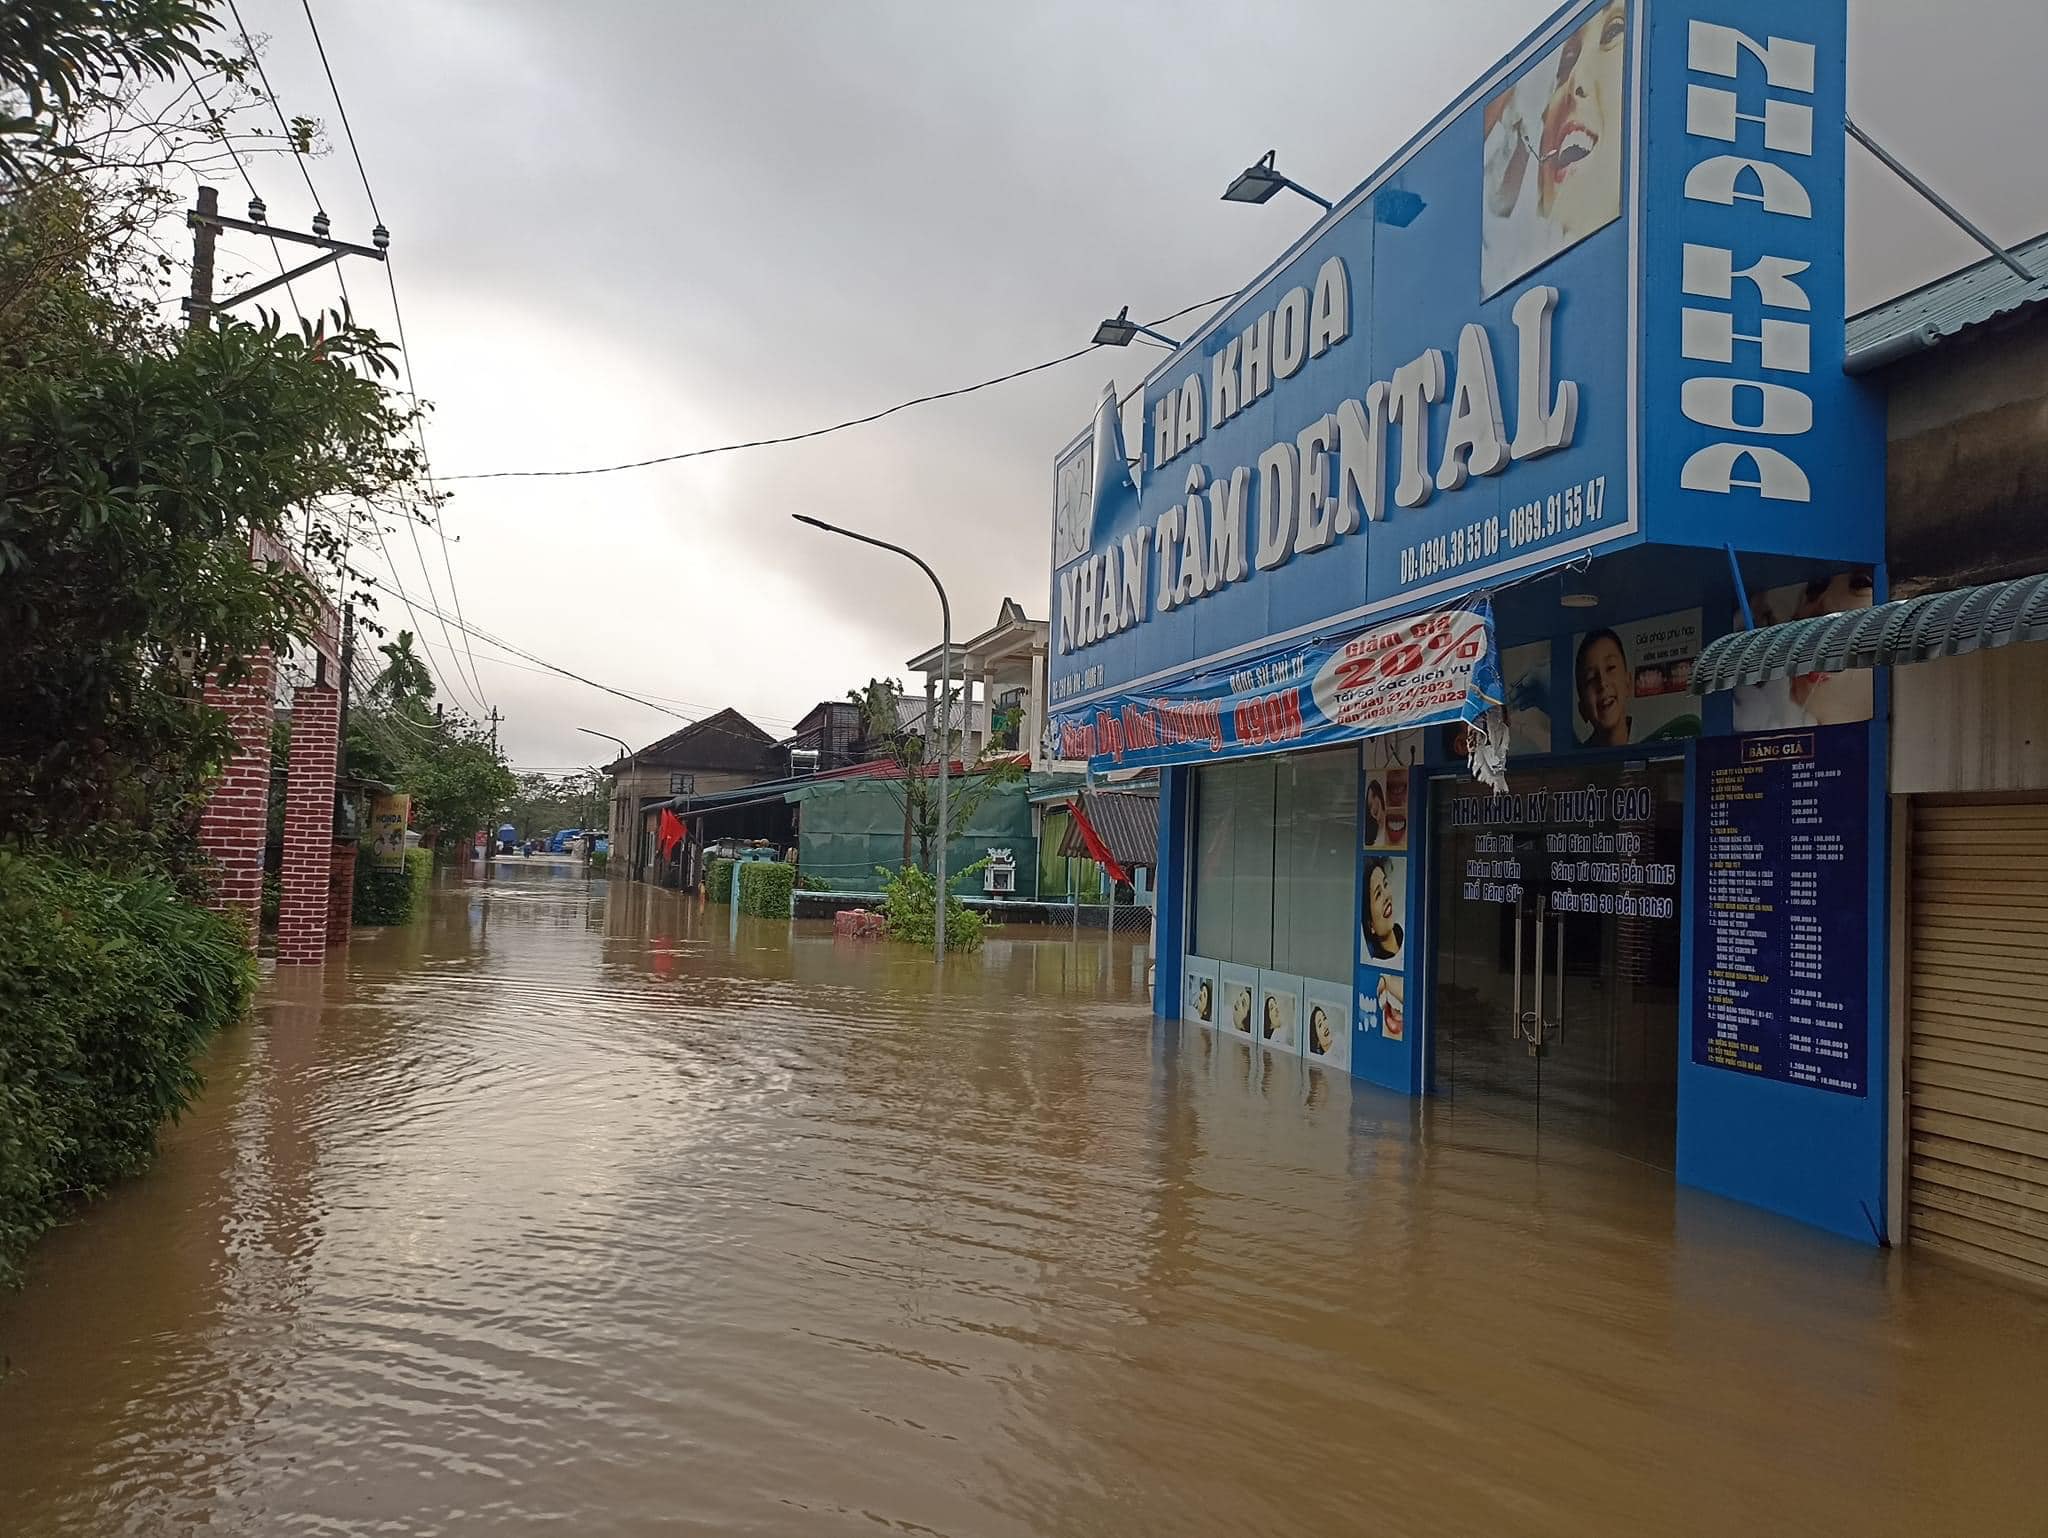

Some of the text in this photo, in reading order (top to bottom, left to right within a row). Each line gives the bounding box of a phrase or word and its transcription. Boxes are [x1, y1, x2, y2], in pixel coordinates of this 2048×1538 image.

[1681, 19, 1815, 502] NHA KHOA
[1212, 256, 1350, 429] KHOA
[1155, 463, 1250, 611] TÂM
[1255, 285, 1577, 571] DENTAL
[1467, 521, 1482, 562] 55
[1565, 484, 1583, 530] 55
[1586, 475, 1606, 521] 47
[1346, 632, 1403, 658] Giảm
[1450, 663, 1471, 679] vụ
[1097, 707, 1124, 765] Dịp
[1234, 687, 1303, 747] 490K
[1749, 740, 1804, 758] BẢNG GIÁ
[1452, 796, 1480, 826] NHA
[1483, 794, 1524, 825] KHOA
[1553, 783, 1608, 829] THUẬT
[1612, 786, 1651, 821] CAO
[1568, 833, 1591, 853] Gian
[1616, 831, 1641, 857] Việc
[1551, 860, 1575, 883] Sáng
[1590, 862, 1620, 883] 07h15
[1621, 858, 1644, 883] Đến
[1645, 863, 1676, 886] 11h15
[1483, 882, 1505, 903] Răng
[1551, 887, 1579, 911] Chiều
[1599, 894, 1614, 914] 30
[1615, 889, 1638, 915] Đến
[1638, 896, 1674, 919] 18h30
